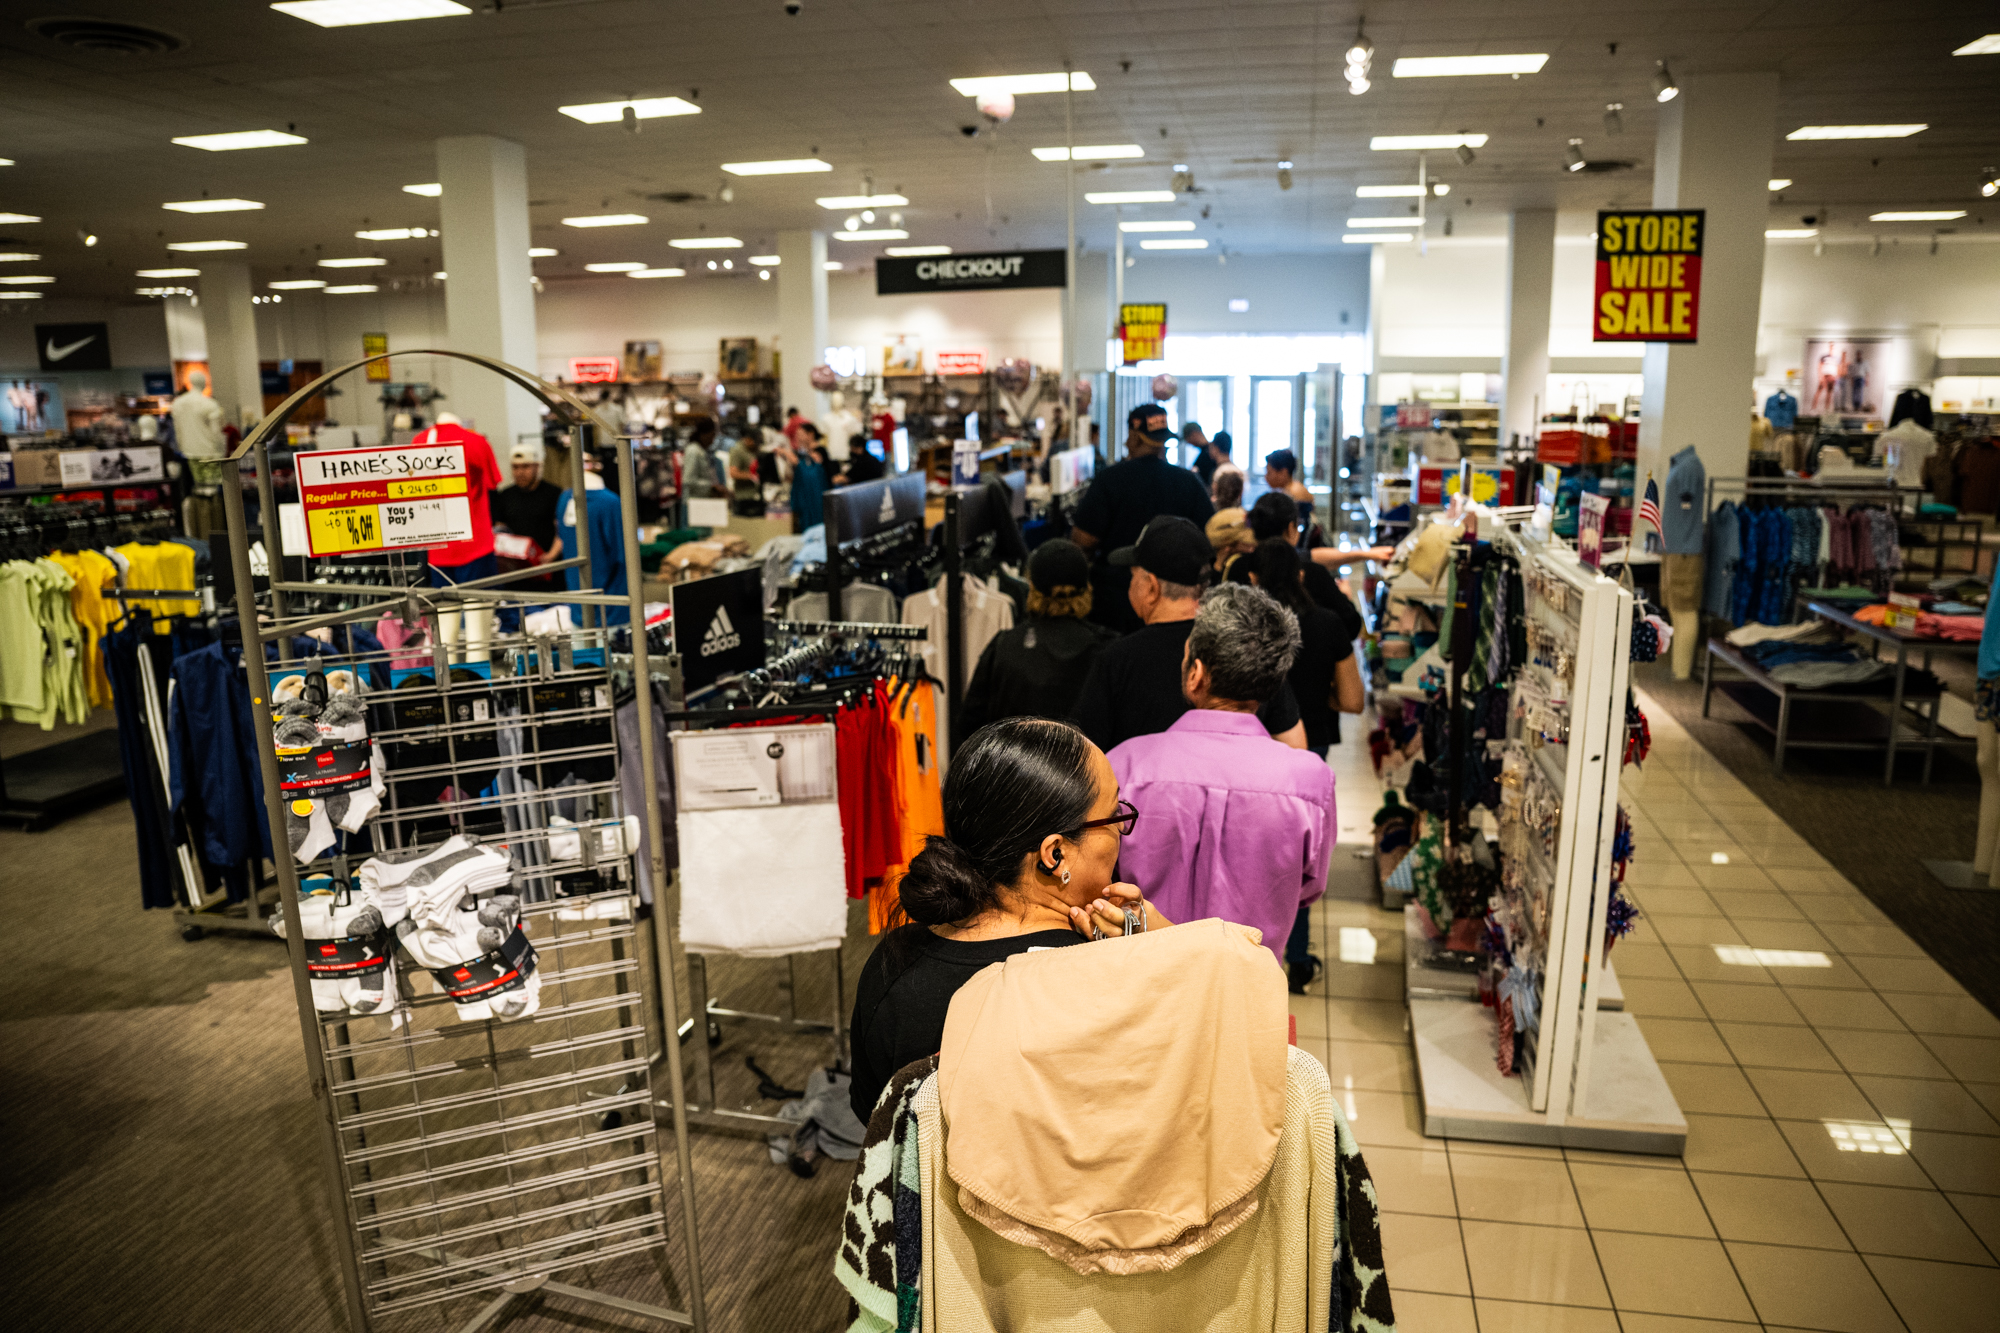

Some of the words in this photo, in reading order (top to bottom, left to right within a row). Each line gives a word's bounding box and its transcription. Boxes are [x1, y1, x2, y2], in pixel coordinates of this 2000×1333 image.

[1602, 215, 1698, 253] STORE
[916, 256, 1024, 280] CHECKOUT
[1609, 254, 1686, 289] WIDE
[1599, 290, 1692, 334] SALE
[321, 454, 392, 478] HANE'S
[306, 491, 348, 504] Regular
[350, 488, 387, 499] Price...
[387, 506, 405, 515] You
[408, 506, 414, 520] $
[388, 516, 407, 525] Pay
[347, 516, 359, 545] %
[360, 514, 374, 541] Off
[700, 632, 741, 657] adidas
[302, 779, 323, 787] ULTRA
[324, 775, 352, 784] CUSHION
